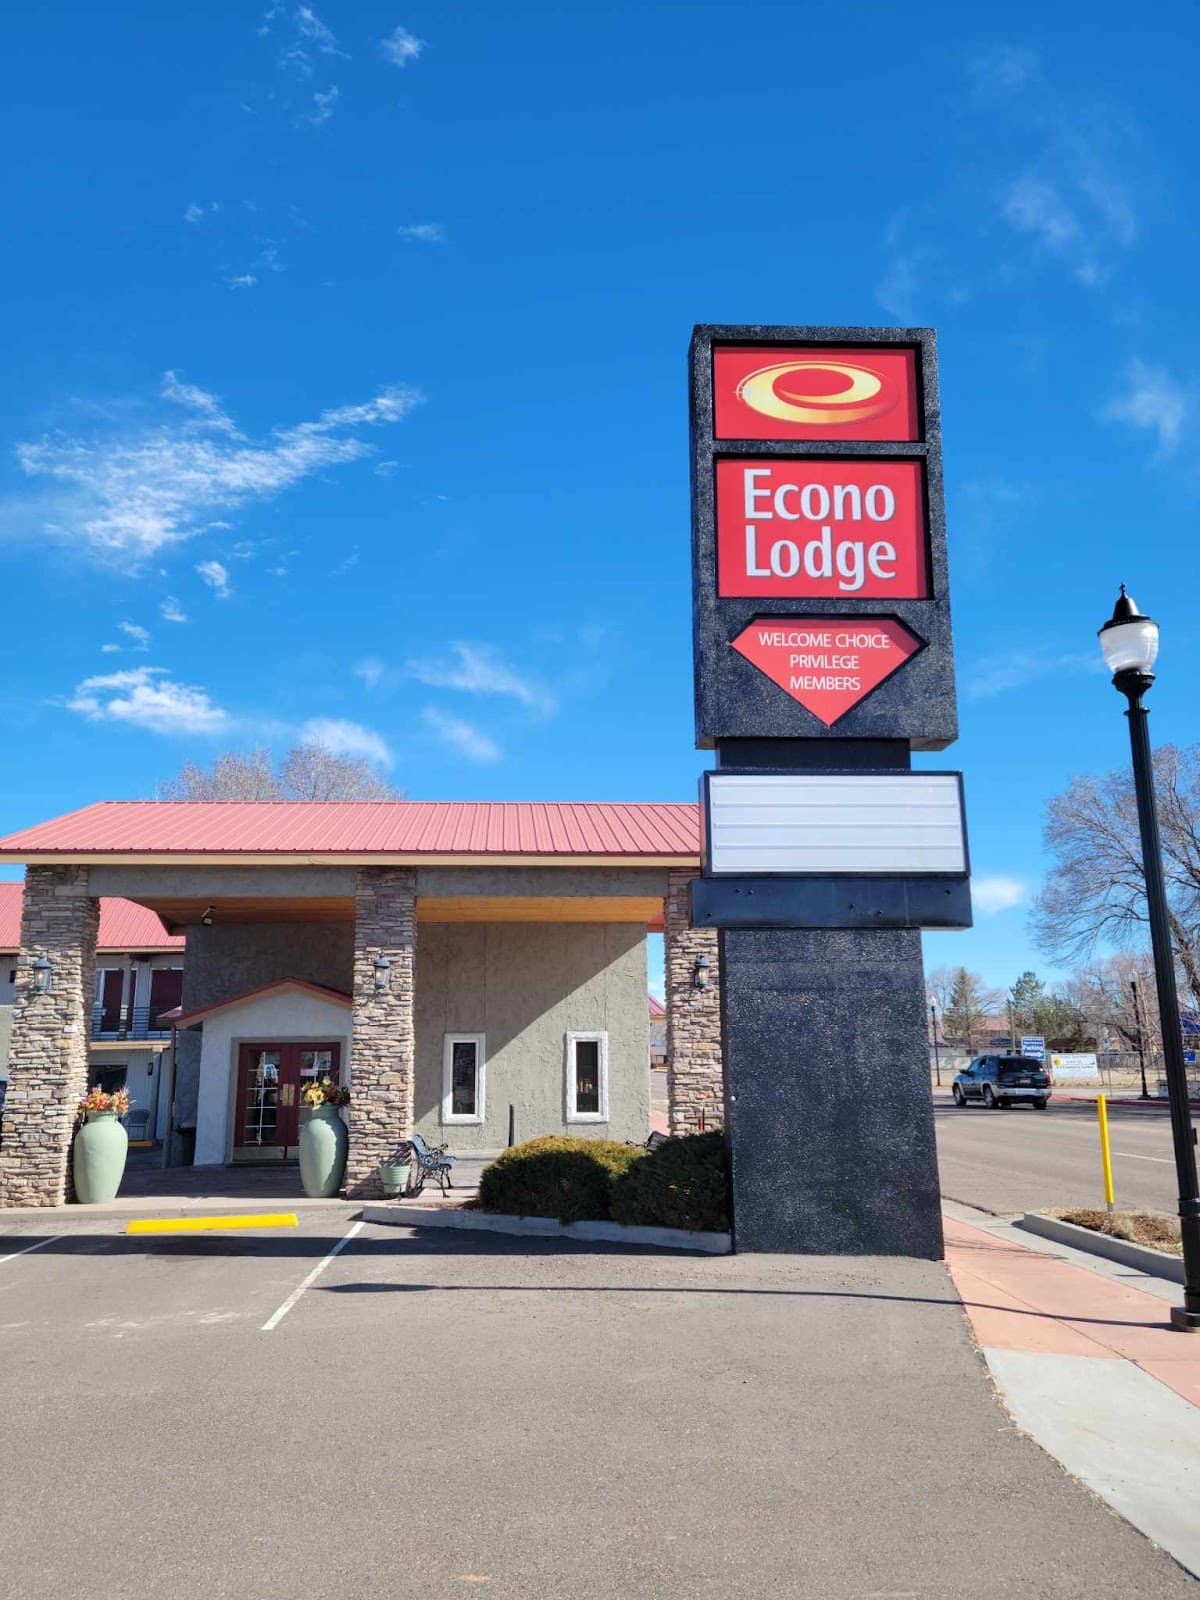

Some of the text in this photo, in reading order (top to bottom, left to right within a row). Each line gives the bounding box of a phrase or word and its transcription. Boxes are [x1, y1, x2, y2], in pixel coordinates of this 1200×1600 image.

[743, 468, 895, 522] Econo
[745, 524, 897, 592] Lodge
[758, 631, 891, 649] WELCOME CHOICE
[789, 653, 860, 670] PRIVILEGE
[789, 675, 862, 692] MEMBERS
